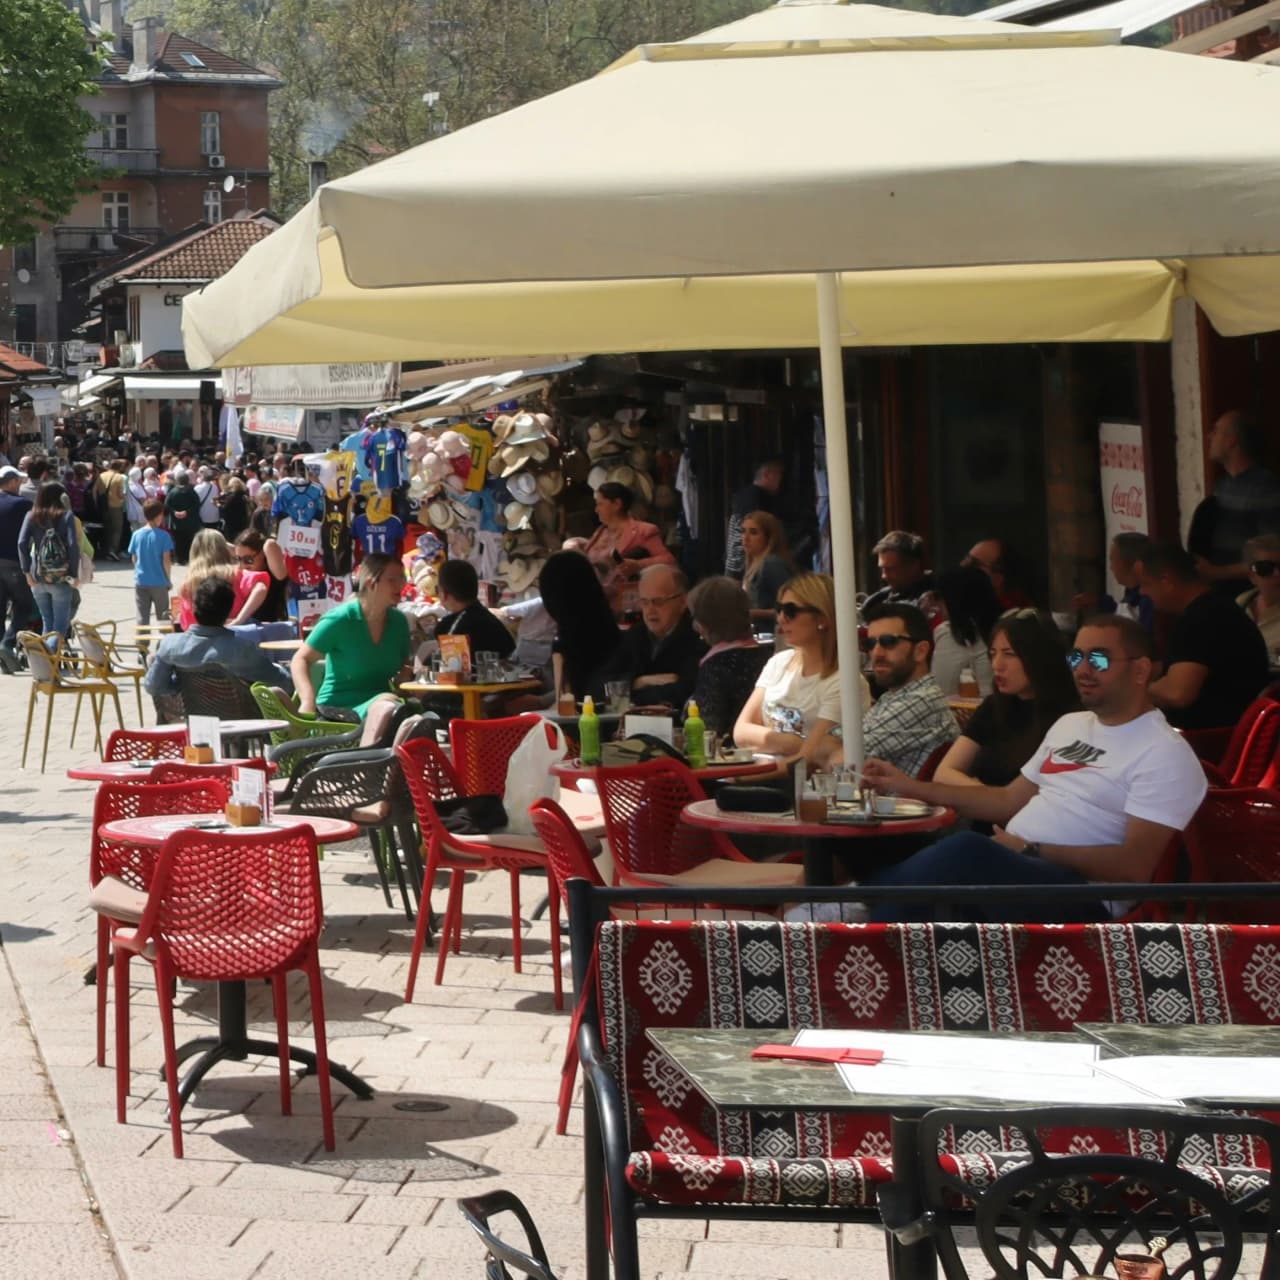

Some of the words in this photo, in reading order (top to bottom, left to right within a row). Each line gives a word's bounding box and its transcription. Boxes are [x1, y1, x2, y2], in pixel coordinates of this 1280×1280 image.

[289, 530, 304, 543] 30
[365, 533, 386, 554] 11
[1053, 739, 1107, 764] NIKE
